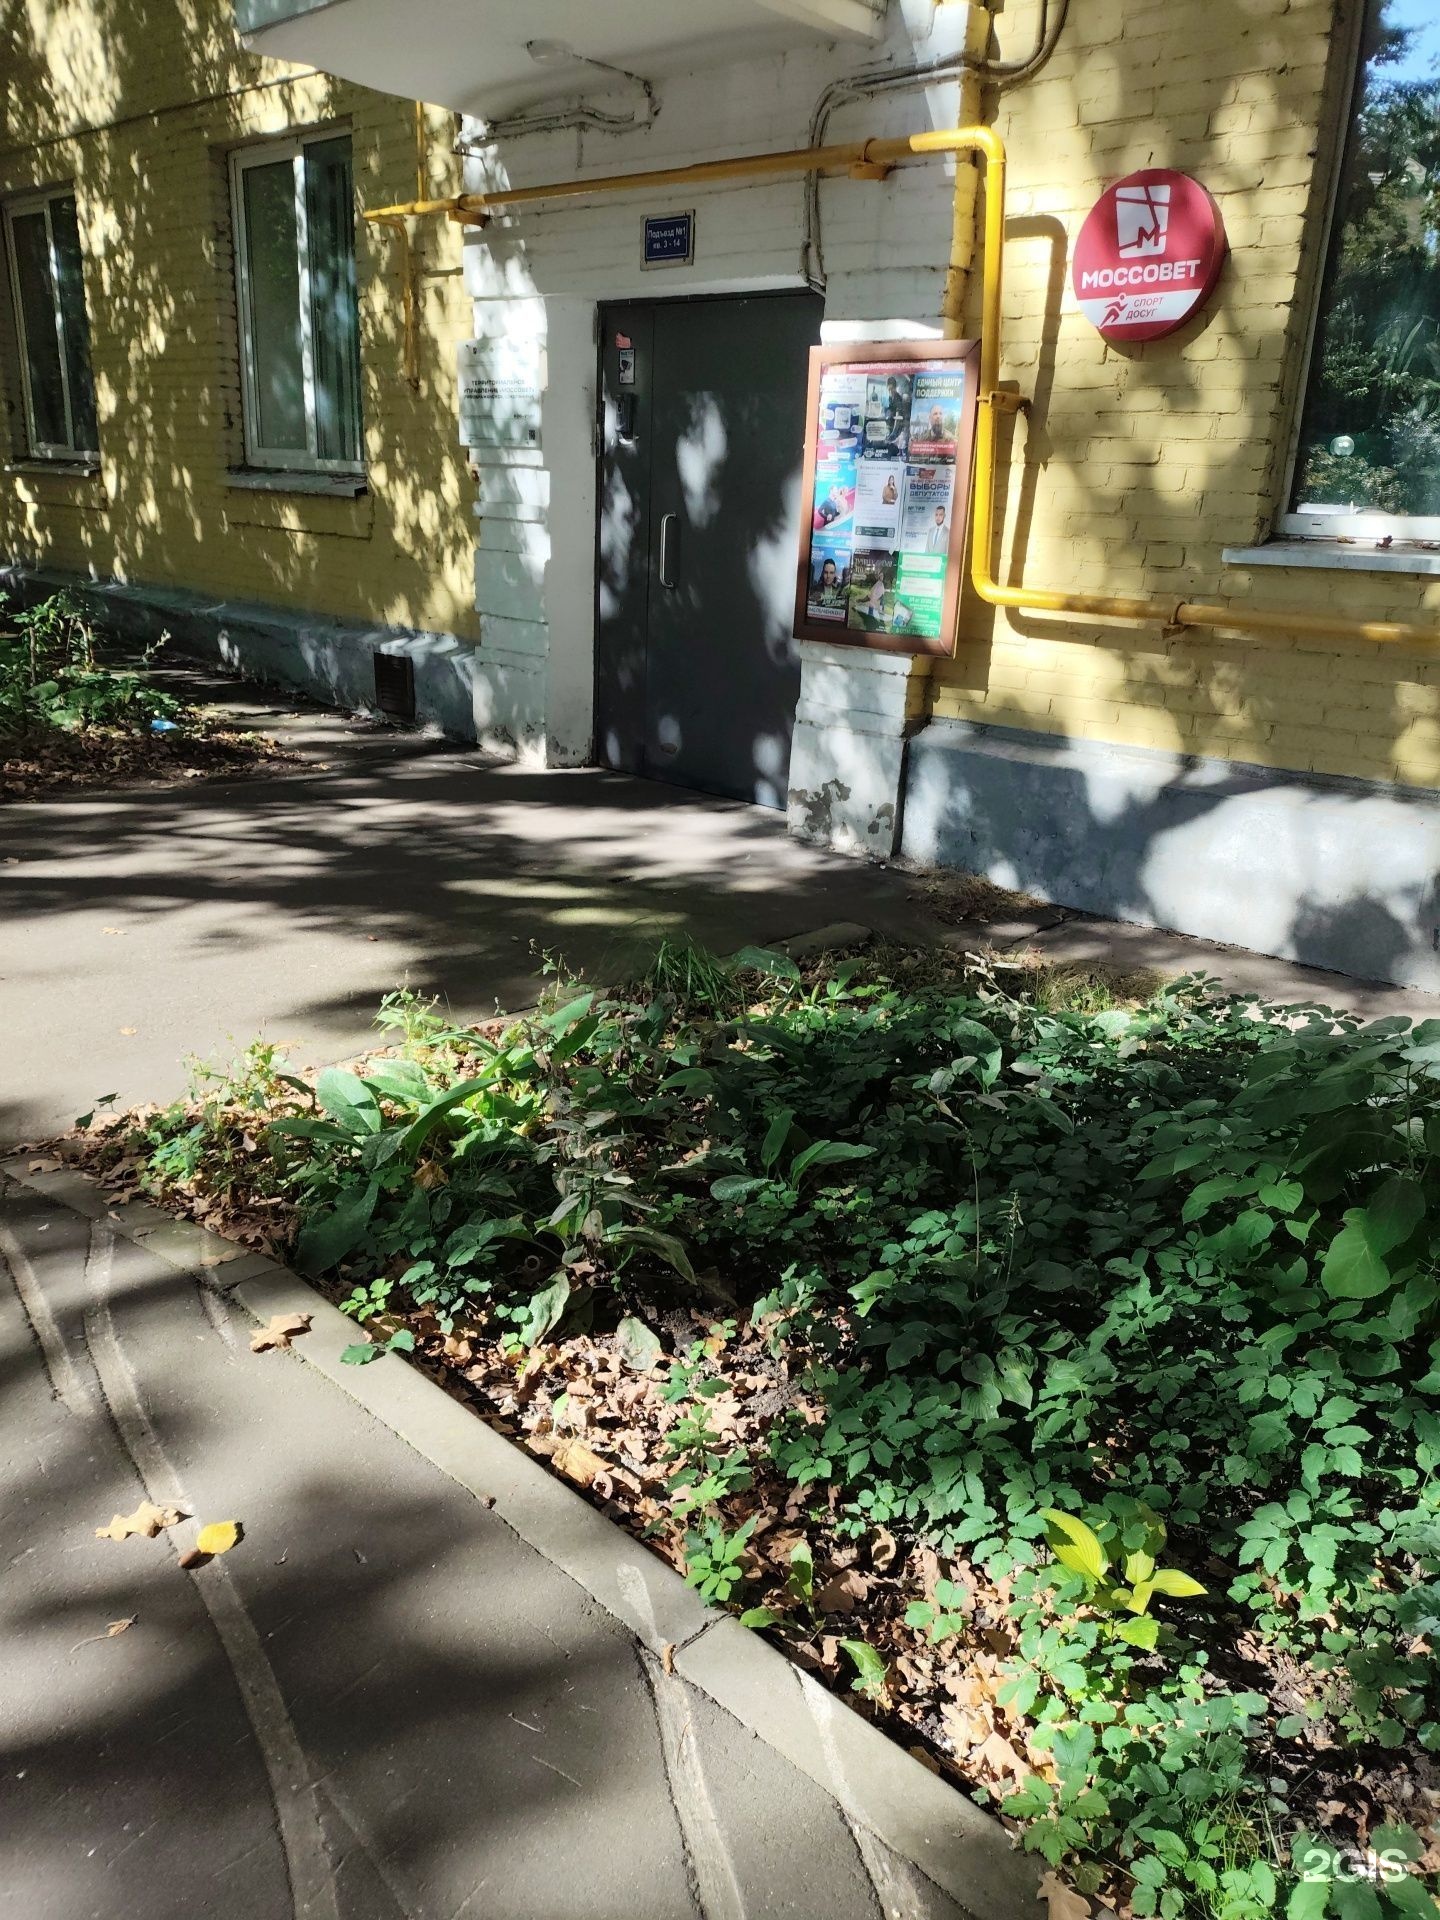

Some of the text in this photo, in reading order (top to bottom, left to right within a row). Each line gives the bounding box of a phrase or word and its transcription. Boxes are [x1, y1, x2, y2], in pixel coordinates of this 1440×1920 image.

[1081, 259, 1201, 290] МОССОВЕТ
[1133, 296, 1164, 307] СПОРТ
[1126, 308, 1158, 321] ДОСУГ
[916, 388, 955, 398] ПОДДЕРЖКИ
[909, 483, 951, 491] ВЫБОРЫ
